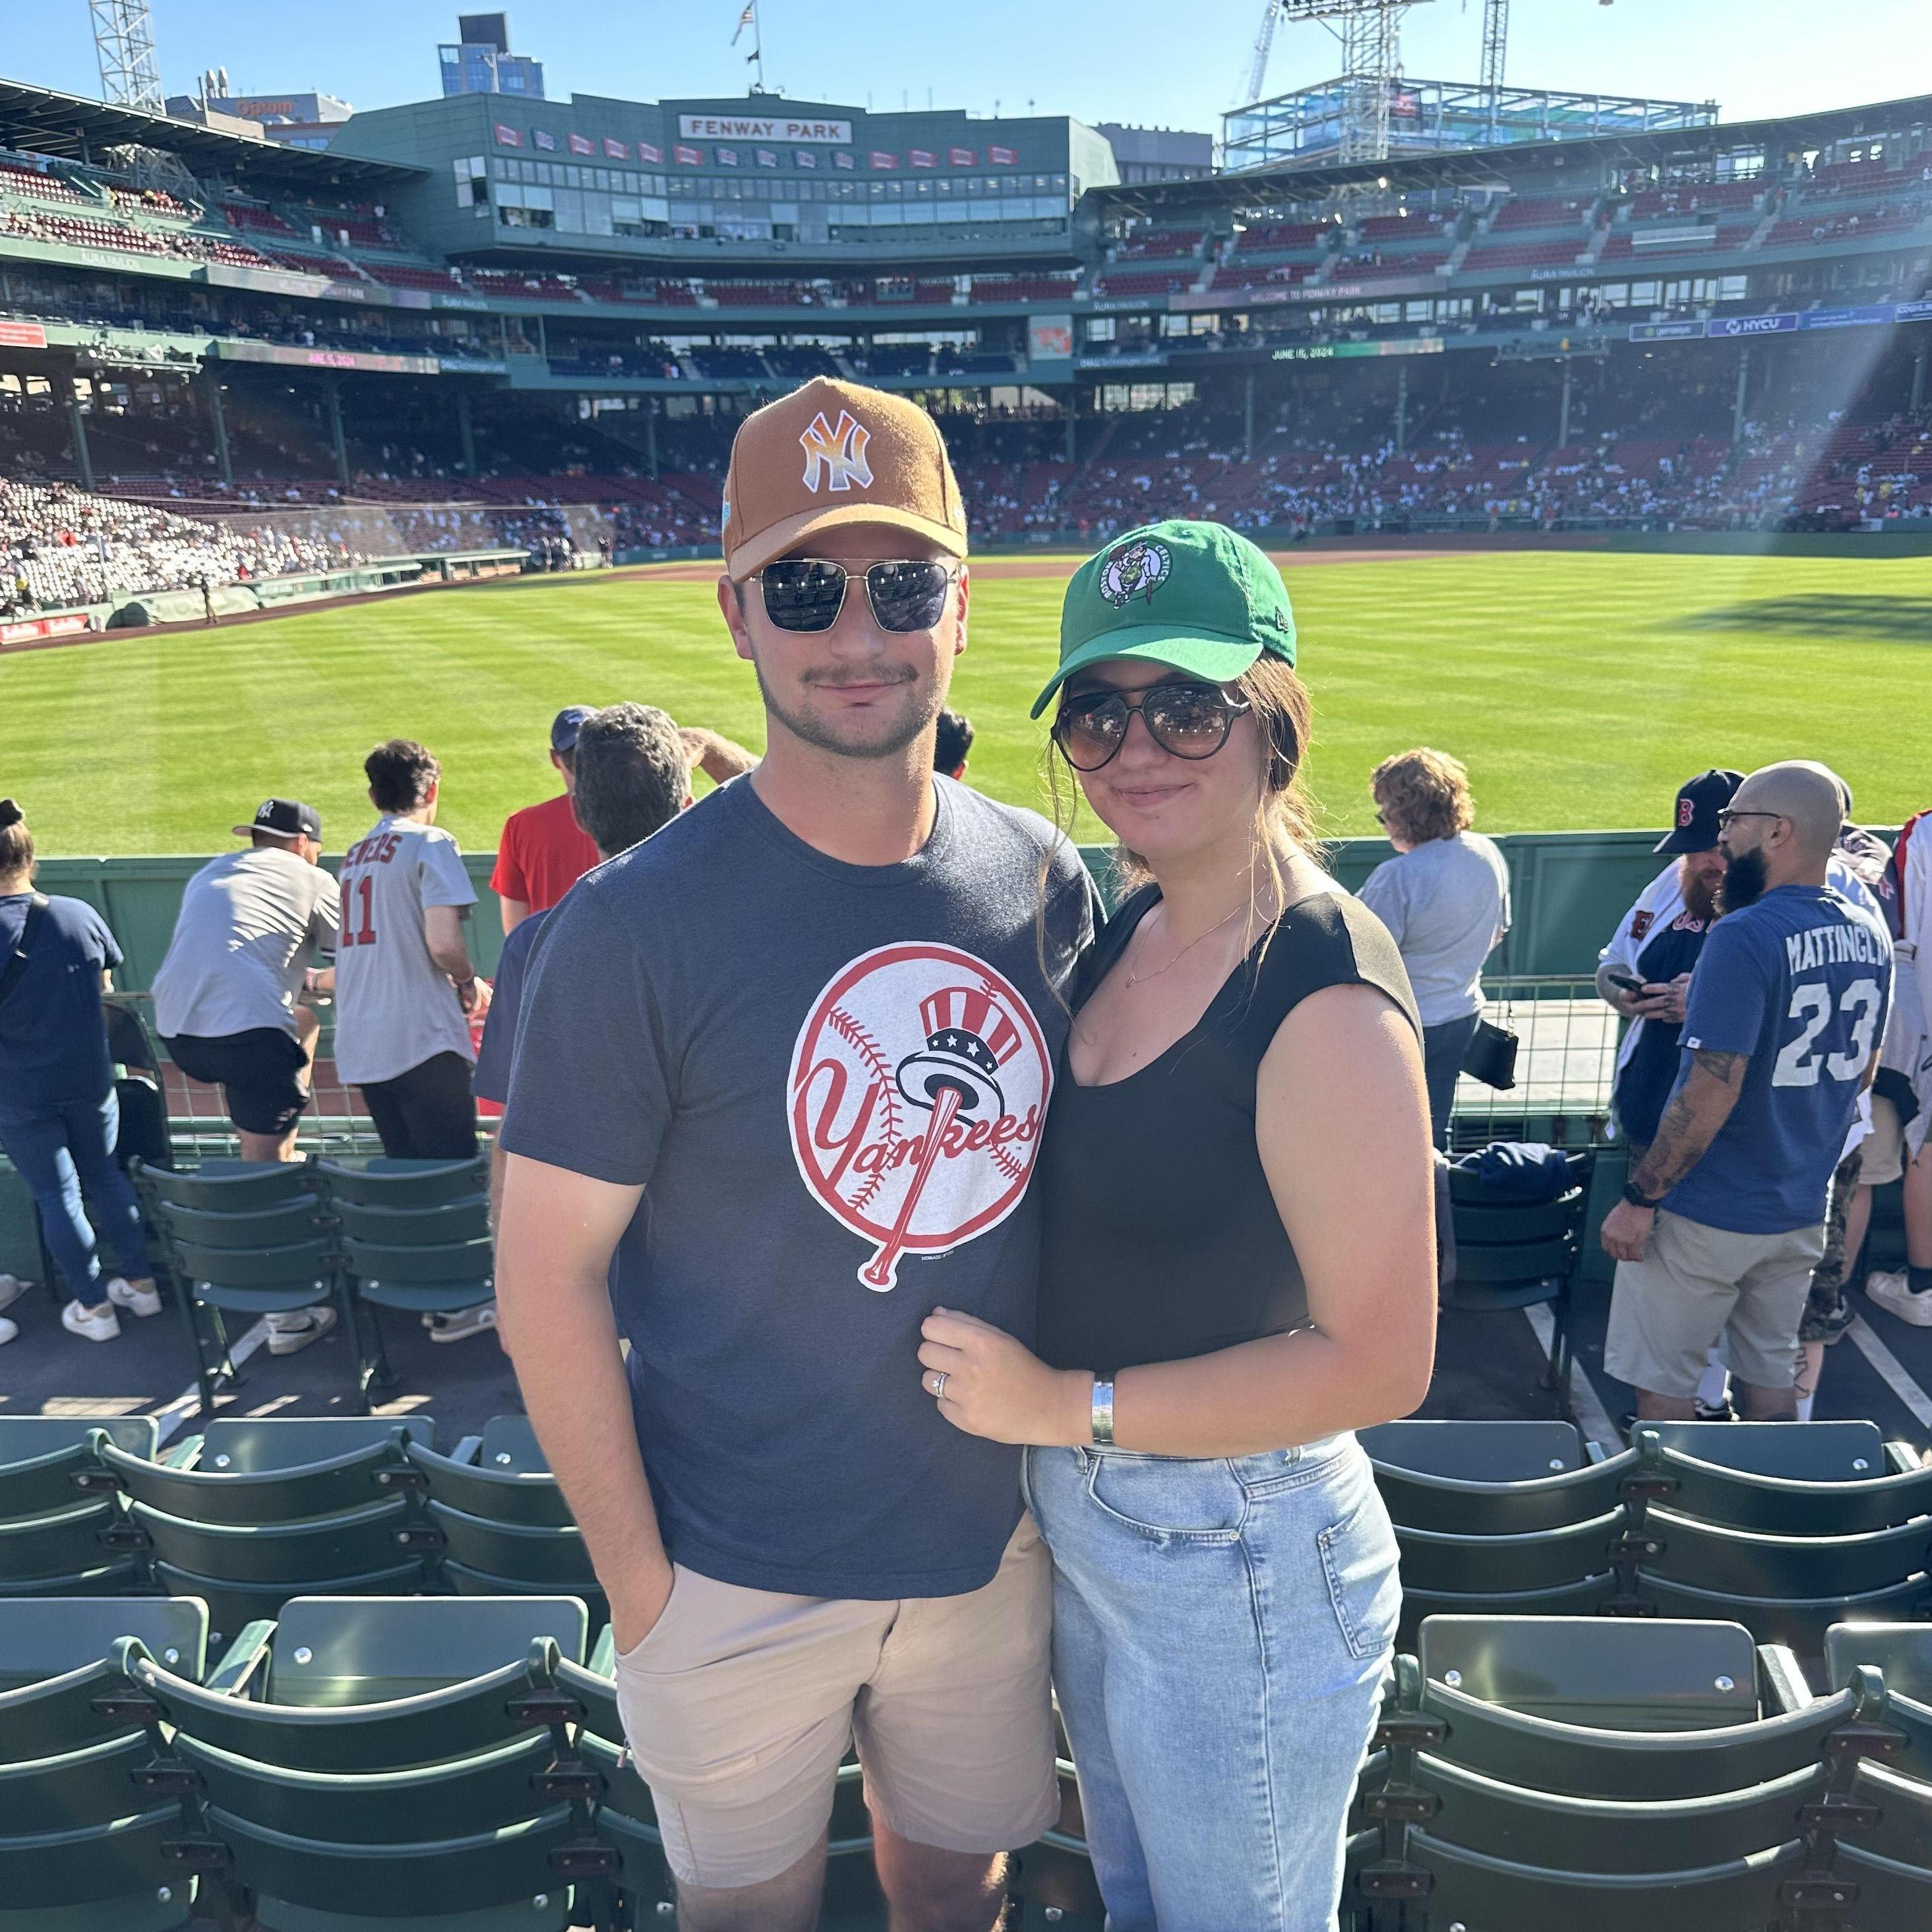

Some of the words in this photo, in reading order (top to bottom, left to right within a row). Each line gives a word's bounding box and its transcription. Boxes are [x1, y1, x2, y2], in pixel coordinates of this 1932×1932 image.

[237, 100, 295, 117] Optum
[690, 119, 774, 136] FENWAY
[787, 123, 841, 138] PARK
[1290, 289, 1302, 300] TO
[1338, 285, 1362, 297] PARK
[1743, 318, 1781, 332] HYCU
[1272, 348, 1296, 360] JUNE
[1310, 346, 1335, 358] 2024
[799, 409, 874, 494] NY
[1155, 544, 1171, 582] CELTICS
[1100, 561, 1114, 599] BOSTON
[1677, 798, 1695, 827] B
[342, 875, 377, 948] 11
[1771, 978, 1881, 1087] 23
[793, 1058, 1041, 1190] Yankees
